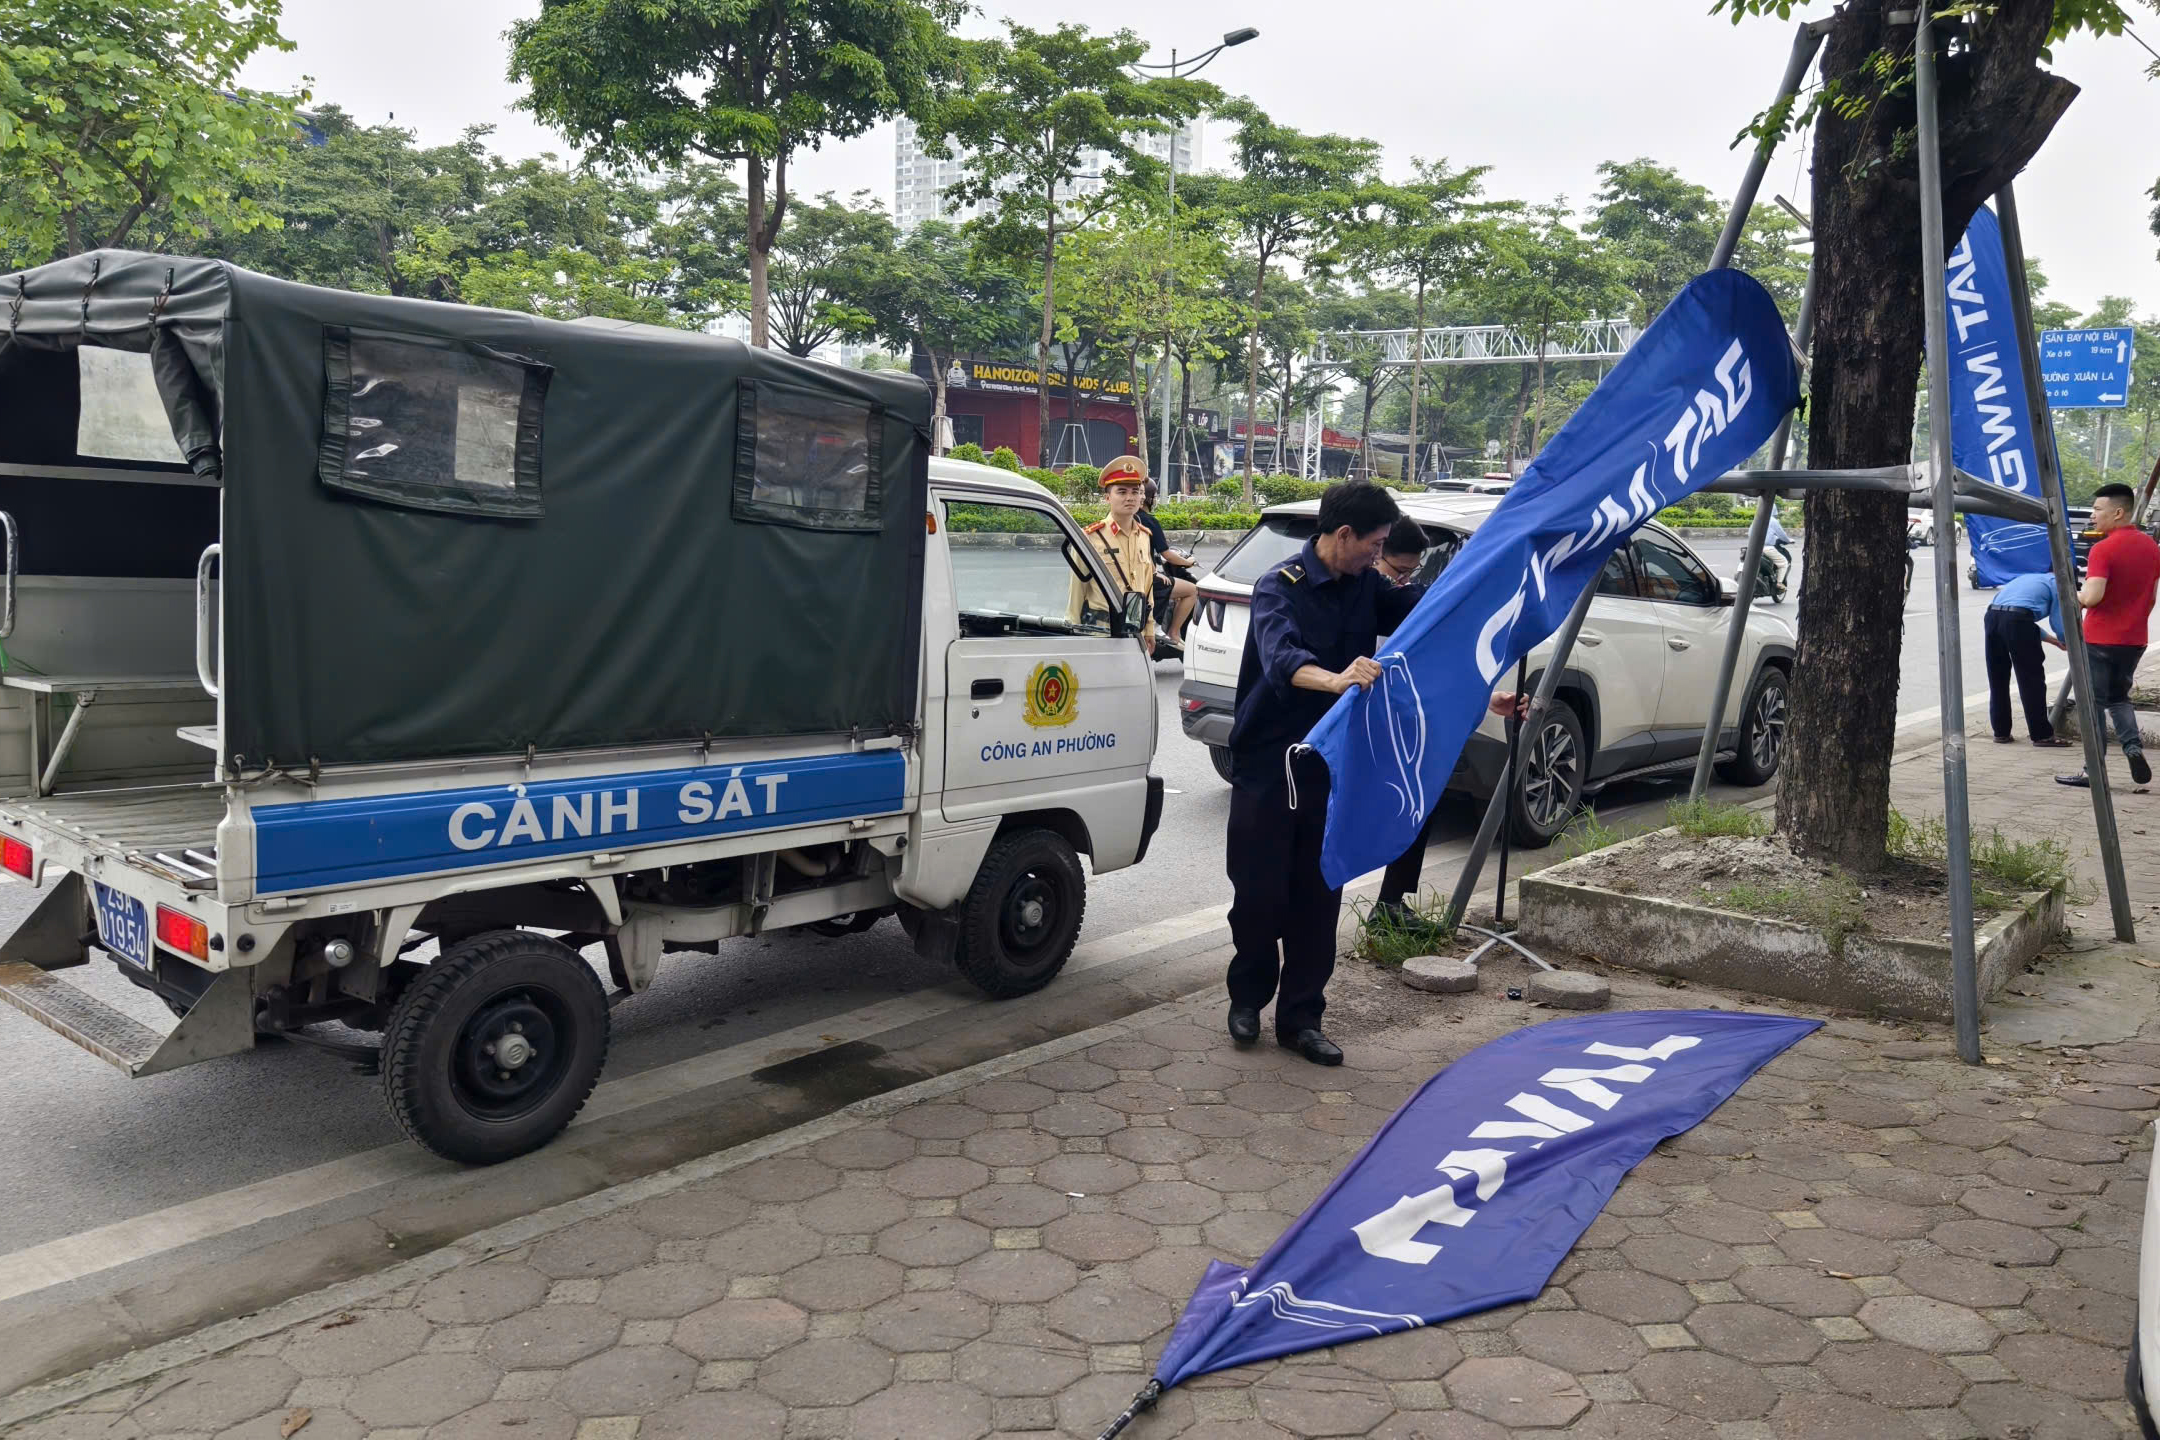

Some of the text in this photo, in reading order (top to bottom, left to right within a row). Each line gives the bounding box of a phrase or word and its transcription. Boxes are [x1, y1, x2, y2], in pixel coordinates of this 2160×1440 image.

[2045, 330, 2118, 343] SÂN BAY NỘI BÀI
[2090, 346, 2113, 354] 19 km
[2046, 350, 2056, 358] Xe
[2074, 371, 2098, 382] XUÂN
[2101, 372, 2114, 381] LA
[1663, 337, 1753, 485] TAG
[1966, 351, 2028, 493] GWM
[981, 730, 1116, 762] CÔNG AN PHƯỜNG
[448, 767, 788, 851] CẢNH SÁT
[101, 907, 145, 961] 019.54
